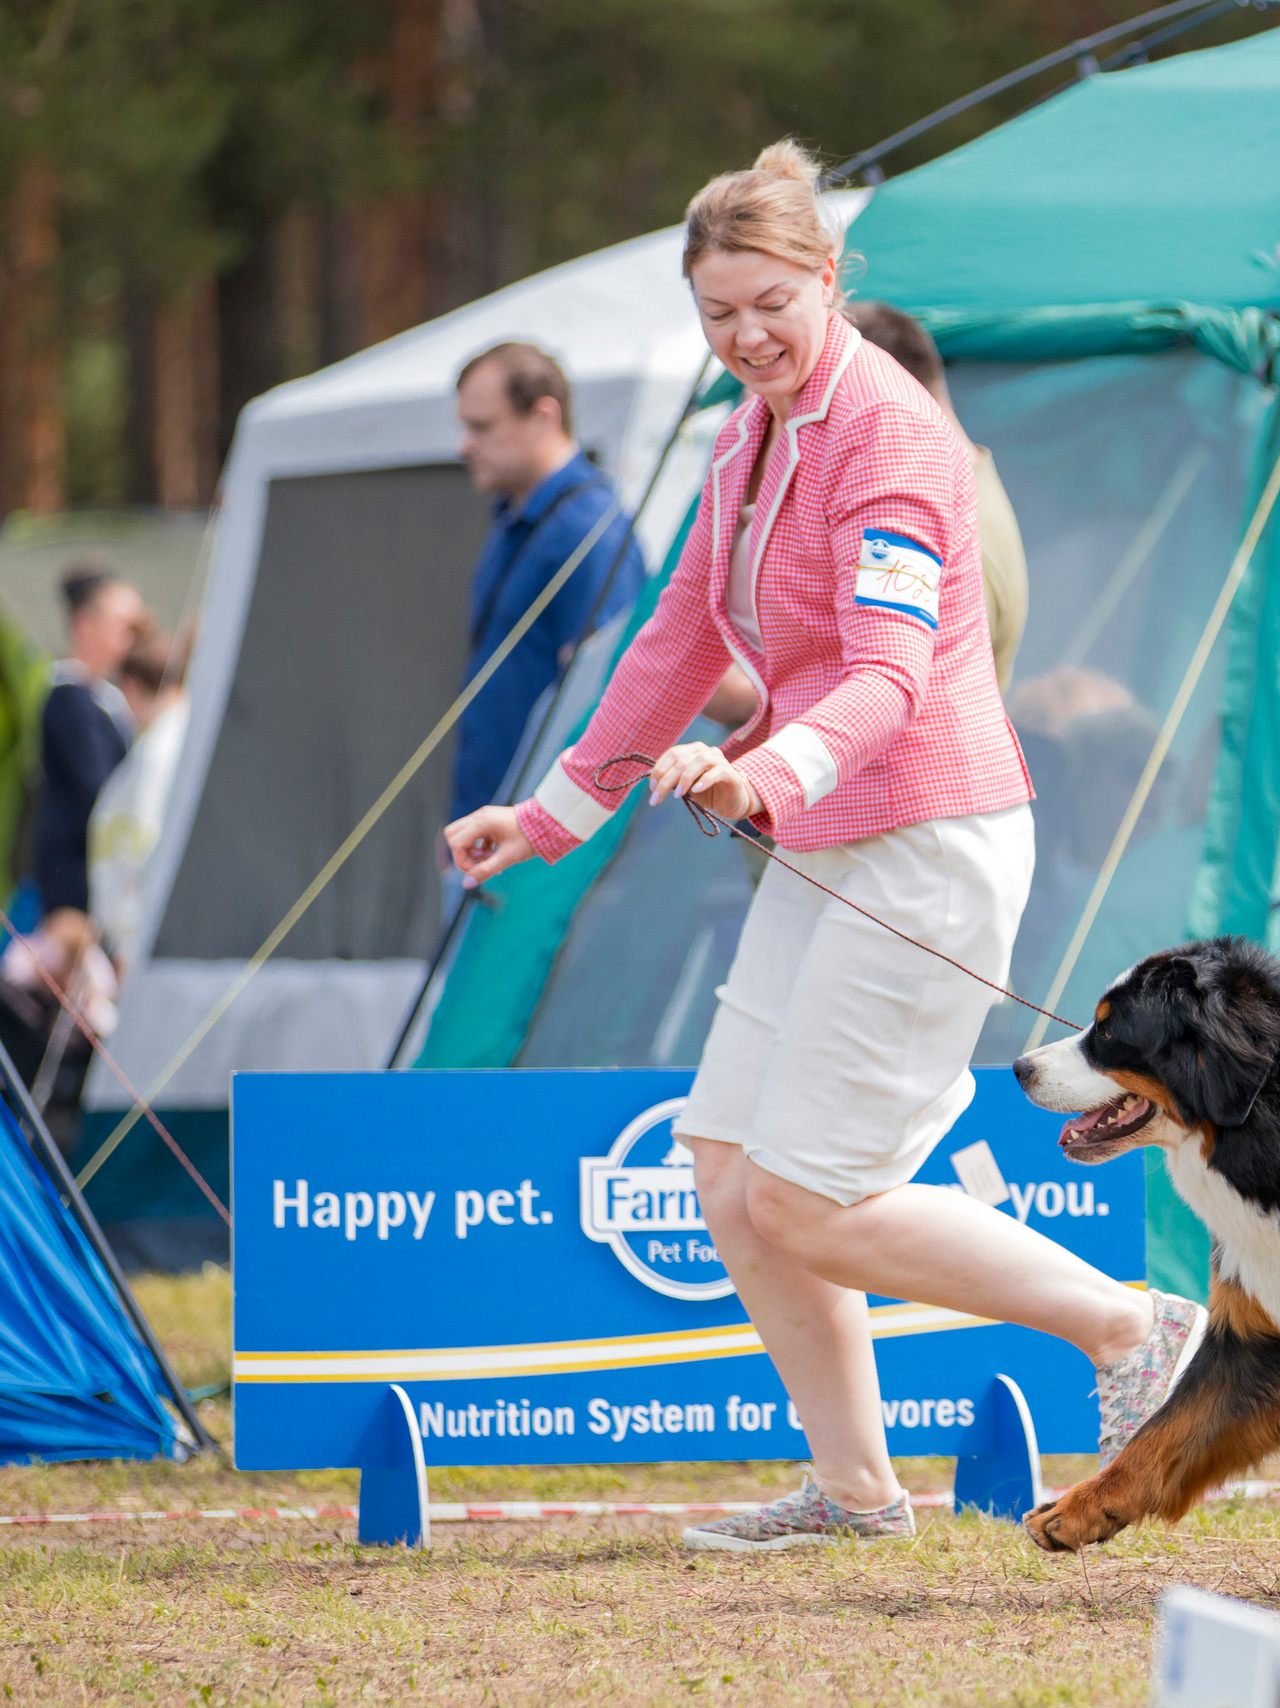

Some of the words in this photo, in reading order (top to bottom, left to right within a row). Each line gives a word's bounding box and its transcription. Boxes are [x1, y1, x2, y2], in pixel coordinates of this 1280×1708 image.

[272, 1179, 436, 1241] Happy
[455, 1179, 554, 1239] pet.
[1008, 1181, 1109, 1224] you.
[648, 1239, 682, 1264] Pet
[420, 1398, 575, 1438] Nutrition
[587, 1397, 716, 1443] System
[725, 1395, 777, 1432] for
